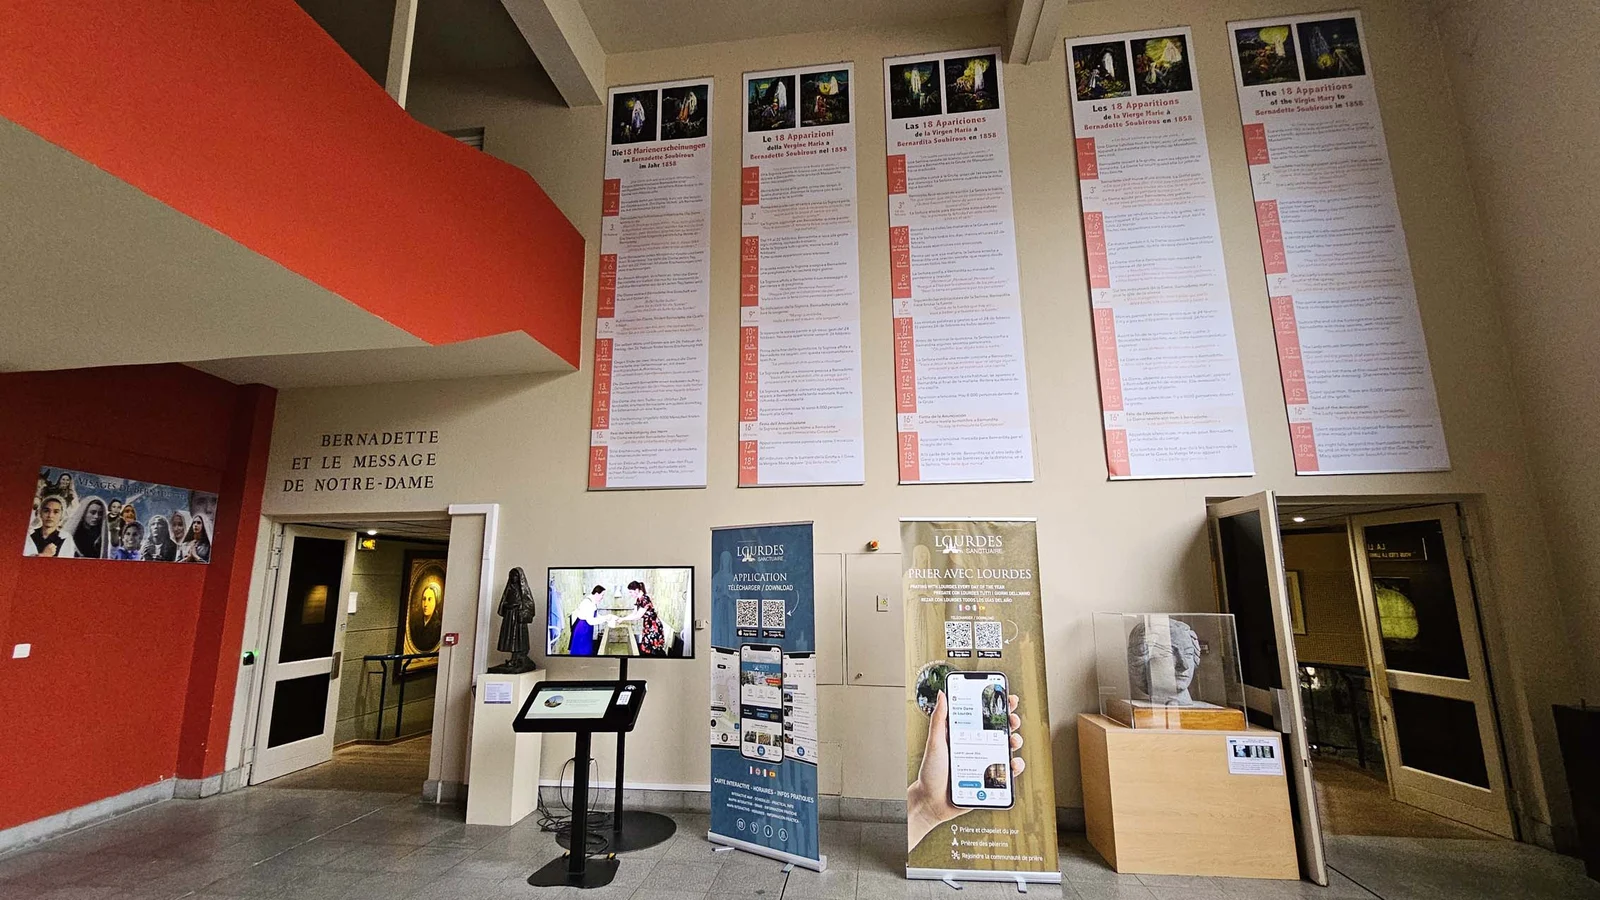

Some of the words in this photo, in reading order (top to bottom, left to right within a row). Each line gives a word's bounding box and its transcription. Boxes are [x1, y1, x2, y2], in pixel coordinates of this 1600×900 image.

[1296, 83, 1353, 95] Apparitions
[1126, 99, 1179, 110] Apparitions
[936, 117, 986, 128] Apariciones
[788, 130, 834, 141] Apparizioni
[634, 143, 706, 154] Marienerscheinungen
[321, 430, 439, 447] BERNADETTE
[292, 456, 311, 470] ET
[322, 456, 341, 469] LE
[353, 454, 437, 468] MESSAGE
[79, 478, 116, 489] VISAGES
[283, 479, 304, 492] DE
[314, 476, 434, 491] NOTRE-DAME
[935, 535, 1002, 547] LOURDES
[737, 545, 784, 557] LOURDES
[733, 573, 787, 581] APPLICATION
[909, 569, 940, 579] PRIER
[944, 569, 973, 579] AVEC
[978, 569, 1032, 579] LOURDES
[727, 779, 750, 790] INTERACTIVE
[753, 786, 773, 795] HORAIRES
[791, 793, 814, 803] PRATIQUES
